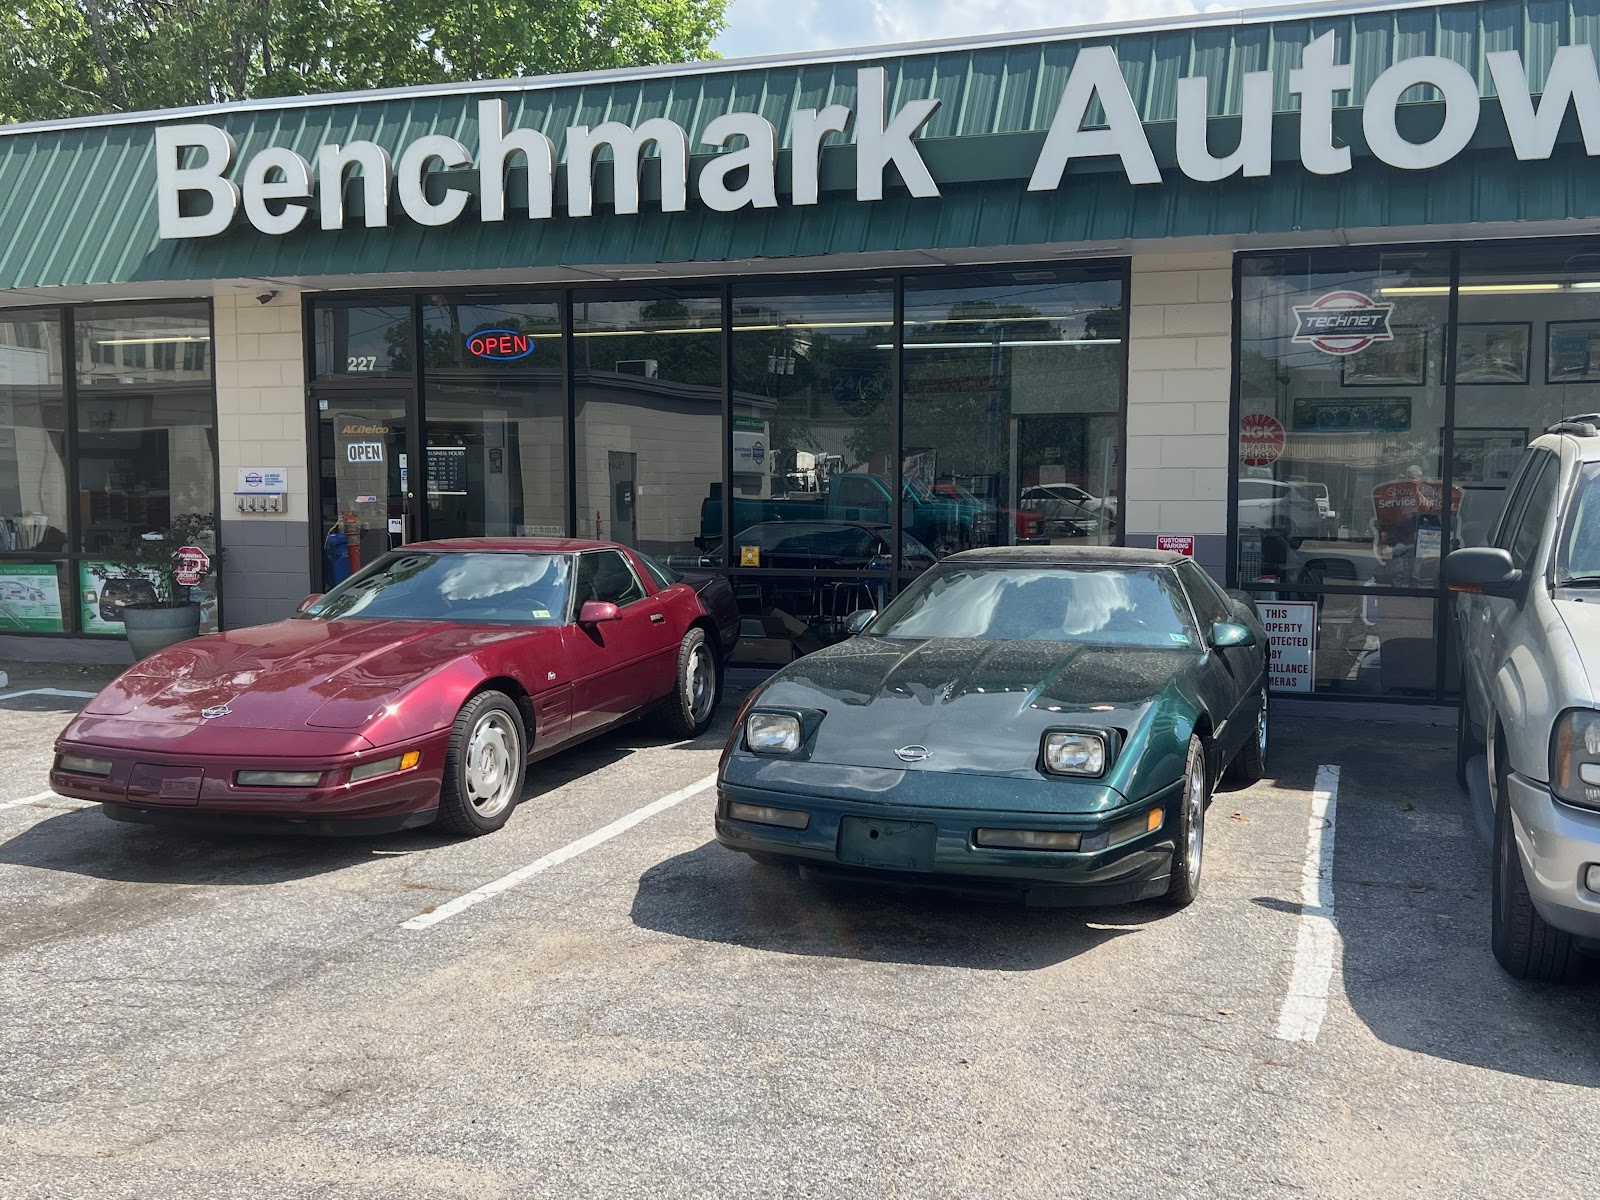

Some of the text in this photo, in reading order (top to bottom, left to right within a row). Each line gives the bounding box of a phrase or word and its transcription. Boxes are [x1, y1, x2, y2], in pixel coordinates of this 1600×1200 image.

[156, 28, 1600, 240] Benchmark Autow
[470, 335, 527, 355] OPEN
[347, 356, 377, 371] 227
[342, 424, 389, 435] ACDelco
[349, 445, 381, 461] OPEN
[1378, 499, 1416, 509] Service
[1265, 609, 1288, 619] THIS
[1265, 623, 1303, 633] OPERTY
[1270, 636, 1308, 647] OTECTED
[1271, 650, 1282, 659] BY
[1269, 664, 1308, 674] EILLANCE
[1269, 678, 1297, 687] MERAS
